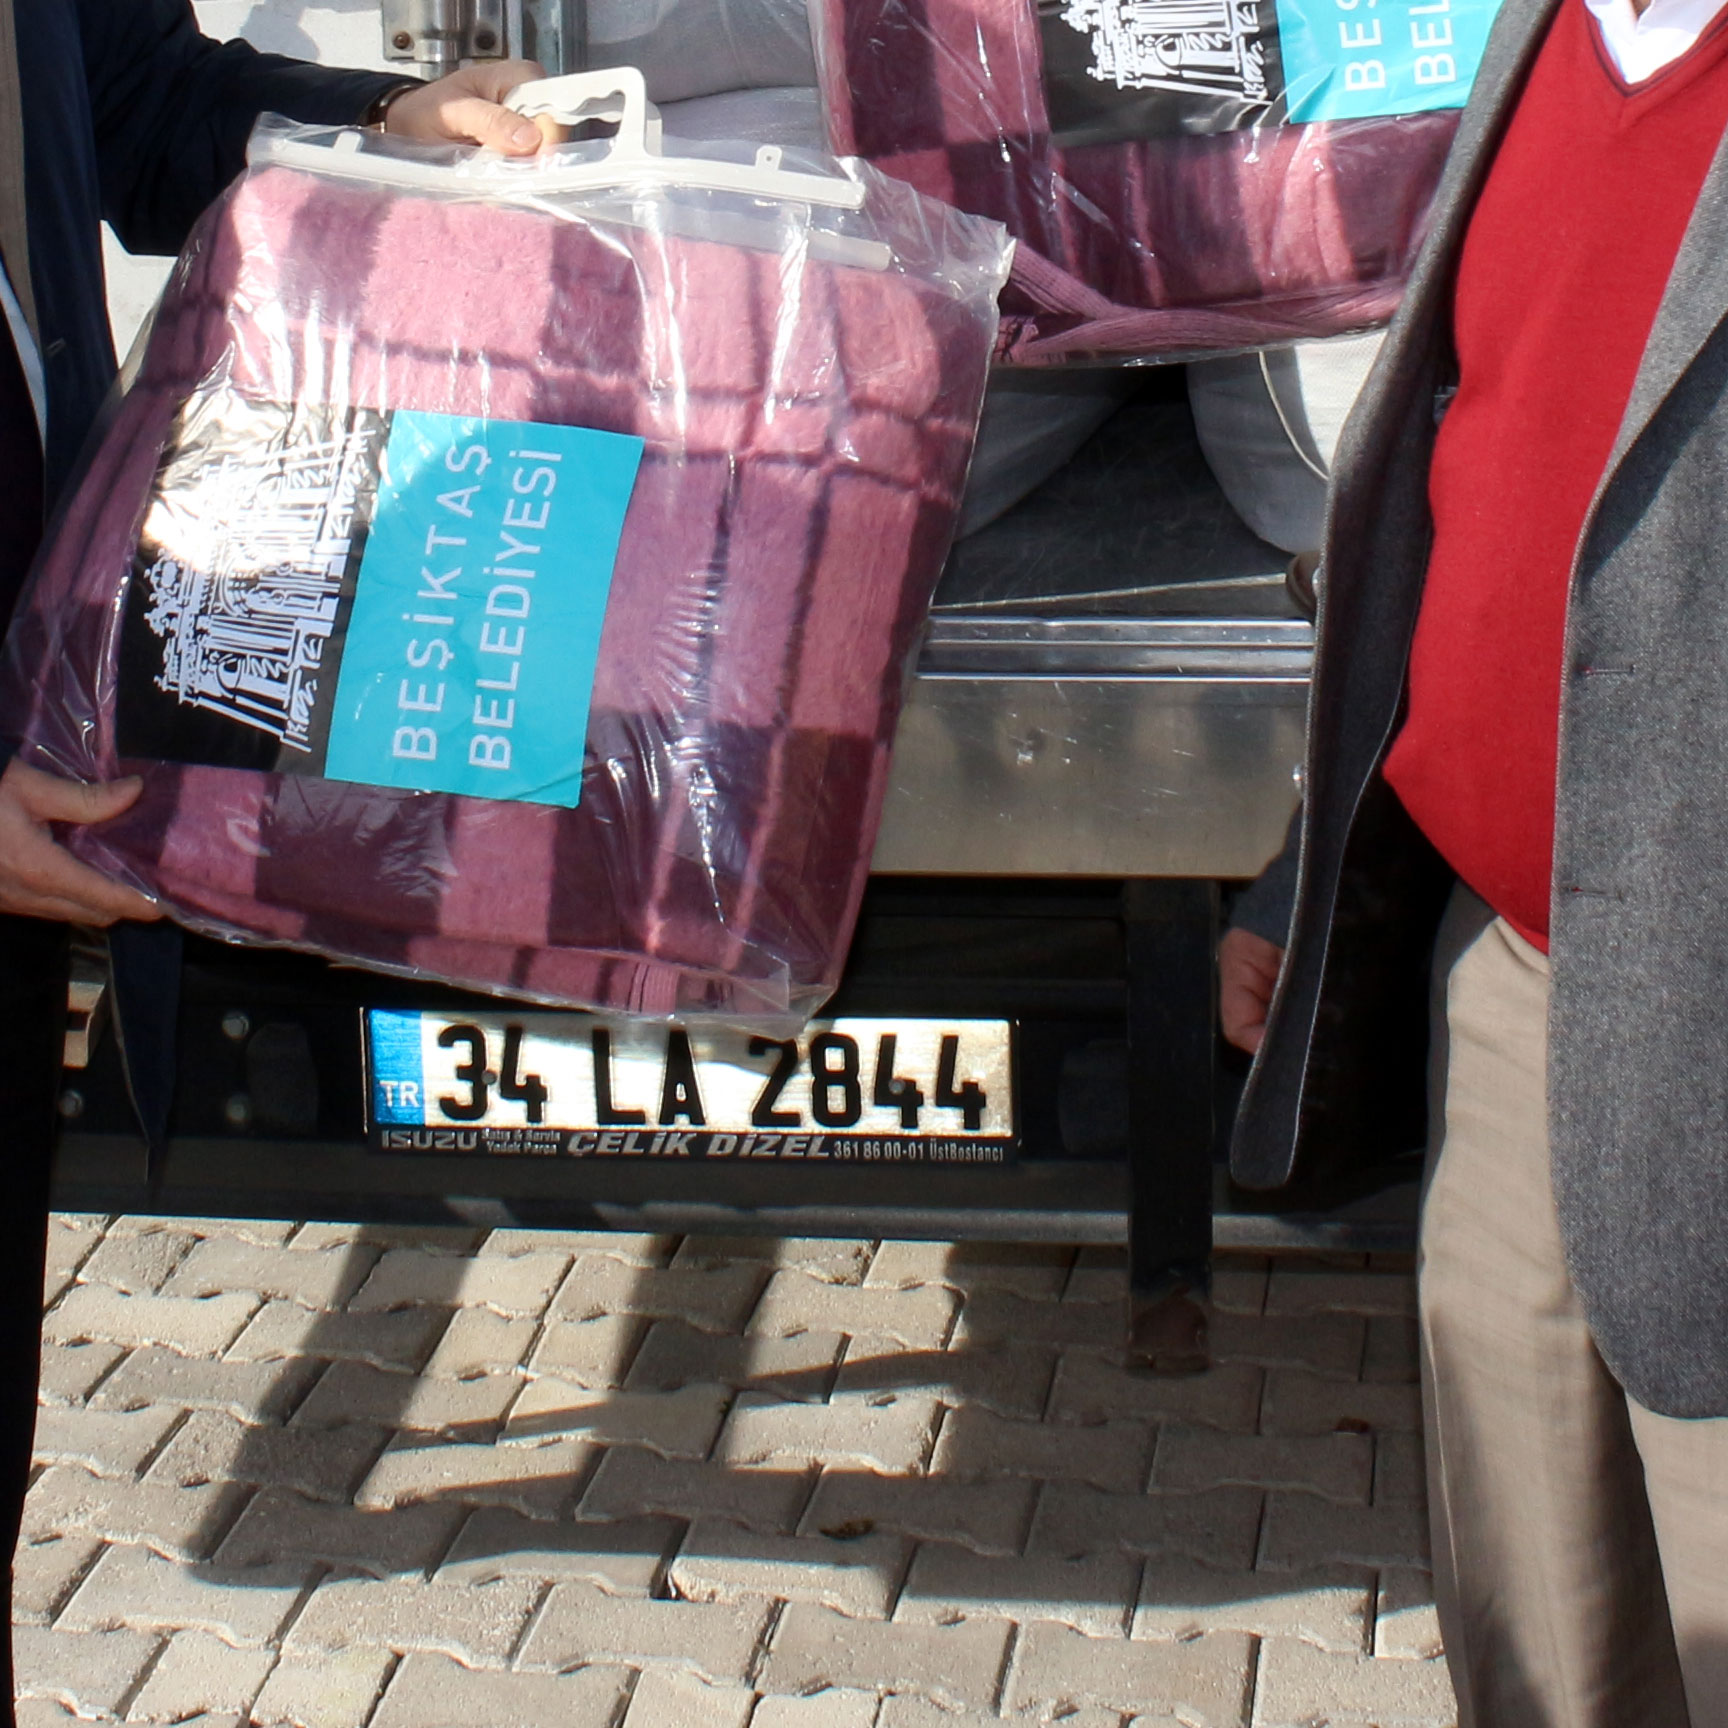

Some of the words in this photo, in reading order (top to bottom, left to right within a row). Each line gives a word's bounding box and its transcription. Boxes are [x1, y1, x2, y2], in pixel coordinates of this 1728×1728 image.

[392, 444, 491, 760] BEŞİKTAŞ
[469, 450, 561, 769] BELEDİYESİ
[437, 1024, 548, 1123] 34
[592, 1025, 705, 1126] LA
[748, 1032, 987, 1130] 2844
[379, 1080, 420, 1108] TR
[381, 1130, 477, 1149] ISUZU
[567, 1130, 697, 1156] ÇELİK
[706, 1133, 829, 1158] DİZEL
[834, 1140, 859, 1158] 361
[863, 1140, 881, 1159] 86
[884, 1141, 923, 1160] 00-01
